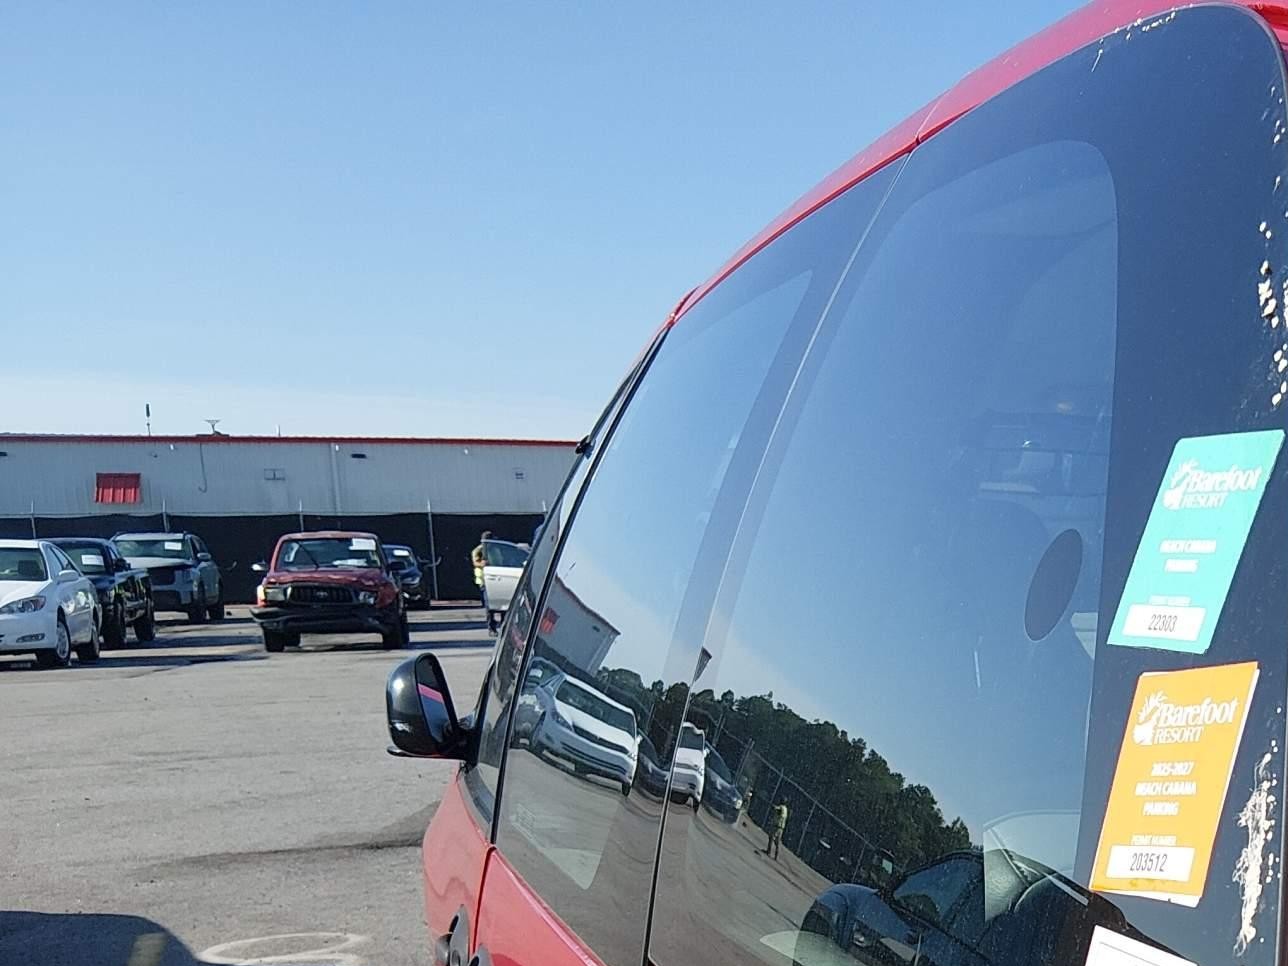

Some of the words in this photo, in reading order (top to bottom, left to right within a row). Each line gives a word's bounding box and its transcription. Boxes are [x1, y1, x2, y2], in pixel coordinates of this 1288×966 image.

[1185, 464, 1263, 493] Barefoot
[1147, 614, 1178, 632] 22303
[1157, 697, 1239, 727] Barefoot
[1153, 727, 1205, 744] RESORT
[1129, 853, 1168, 873] 203512
